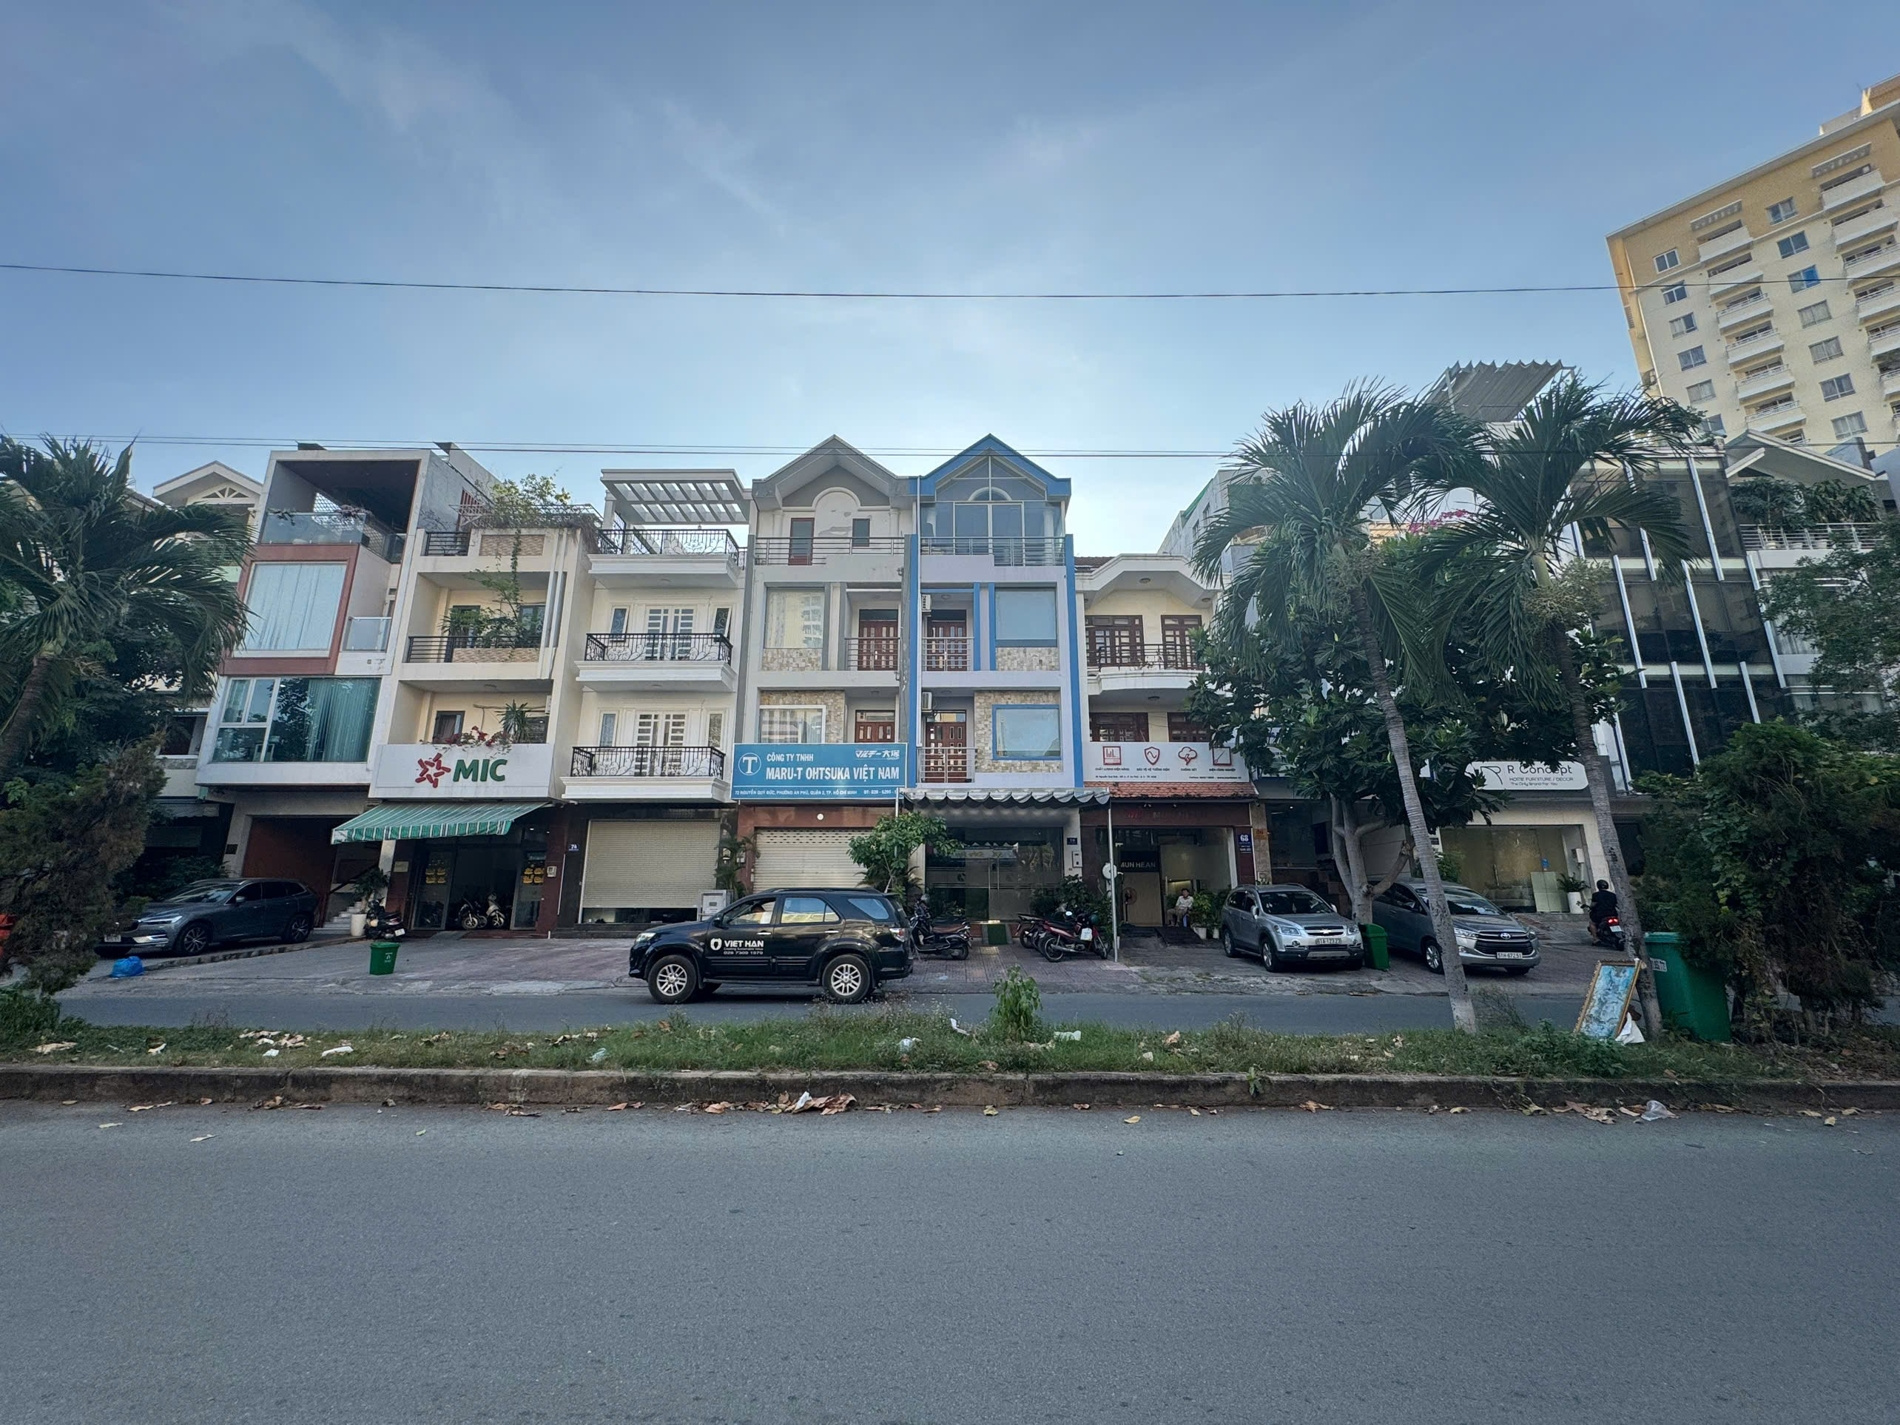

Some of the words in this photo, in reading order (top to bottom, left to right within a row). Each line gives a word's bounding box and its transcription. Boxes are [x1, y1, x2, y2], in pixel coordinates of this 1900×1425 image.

[766, 752, 785, 762] CÔNG
[786, 753, 795, 762] TY
[796, 753, 814, 762] TNHH
[453, 759, 508, 782] MIC
[766, 766, 803, 780] MARU-T
[805, 766, 850, 780] OHTSUKA
[853, 764, 875, 782] VIỆT
[877, 766, 900, 780] NAM
[1507, 765, 1515, 774] R
[1519, 764, 1573, 776] Concpt
[1240, 834, 1249, 842] 68
